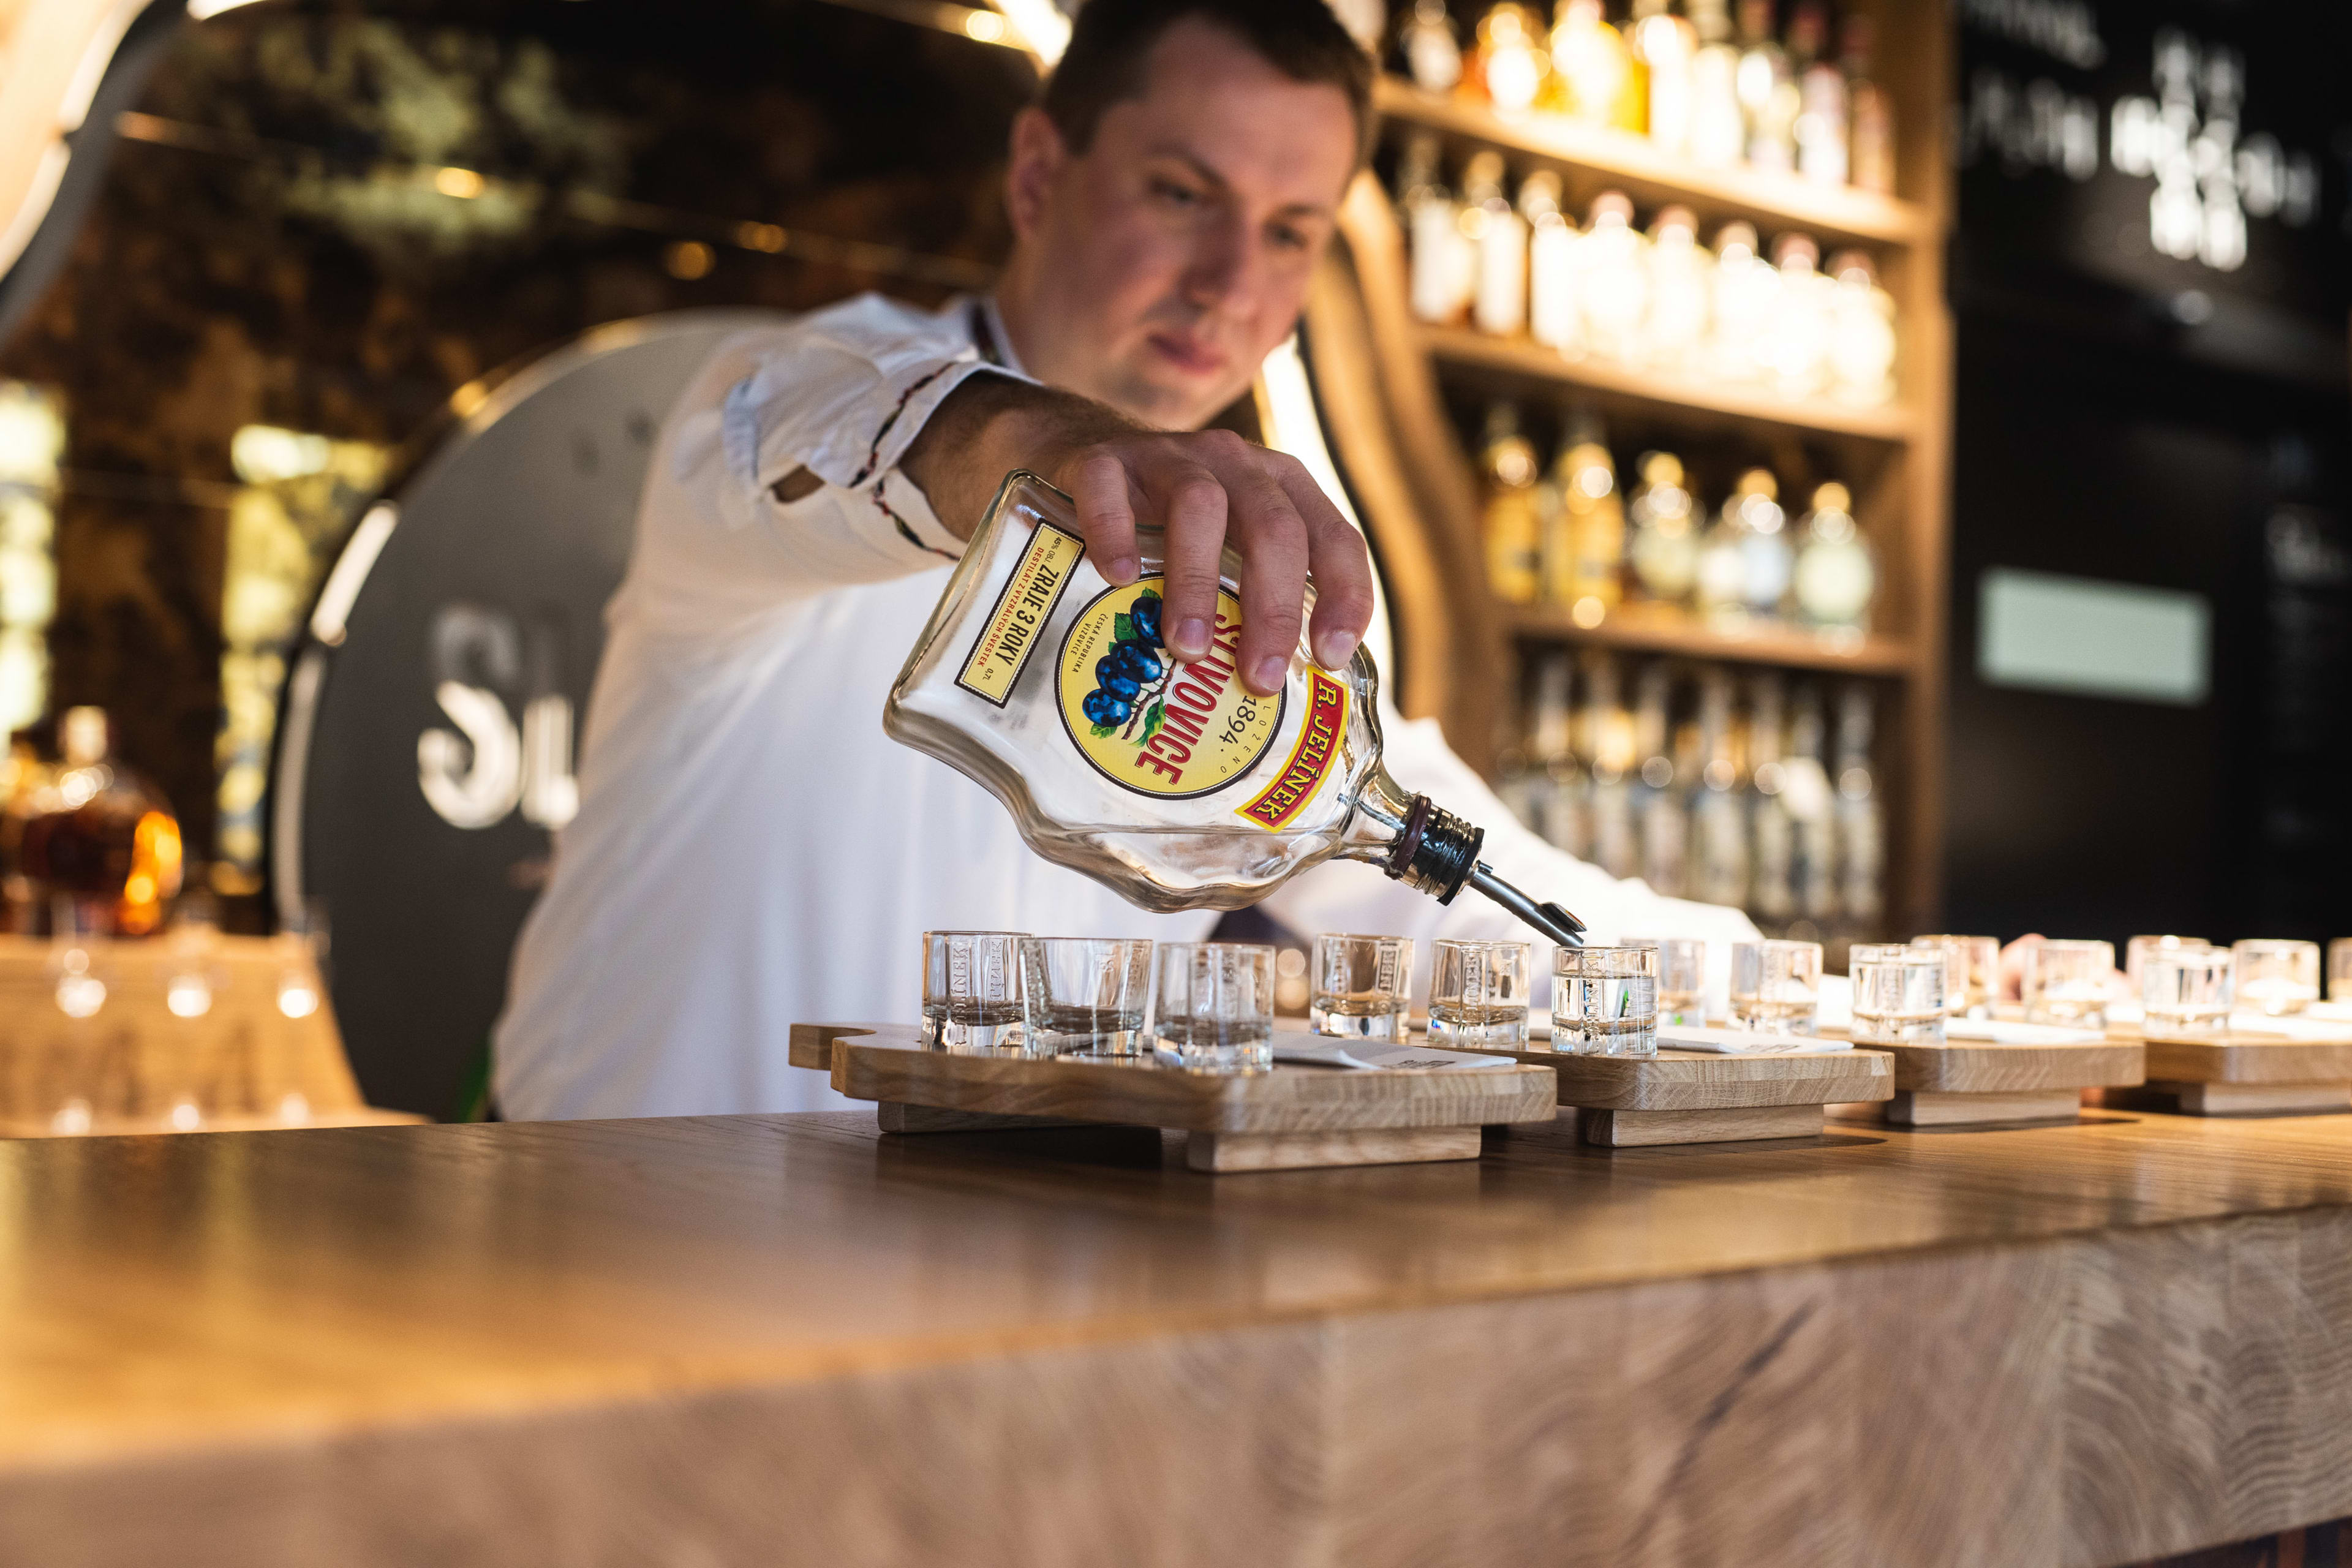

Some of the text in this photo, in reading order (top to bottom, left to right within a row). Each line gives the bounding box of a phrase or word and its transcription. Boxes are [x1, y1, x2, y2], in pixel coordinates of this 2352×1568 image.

[1051, 537, 1062, 549] 45%
[1023, 547, 1044, 582] DESTILÁT
[995, 564, 1060, 666] ZRAJE 3 ROKY
[996, 589, 1022, 631] VYZRÁLÝCH
[977, 632, 1001, 667] ŠVESTEK
[1070, 623, 1091, 654] VIZOVICE
[1072, 613, 1108, 673] ČESKÁ REPUBLIKA
[982, 668, 994, 680] 0,7L
[1256, 681, 1336, 820] R. JELÍNEK
